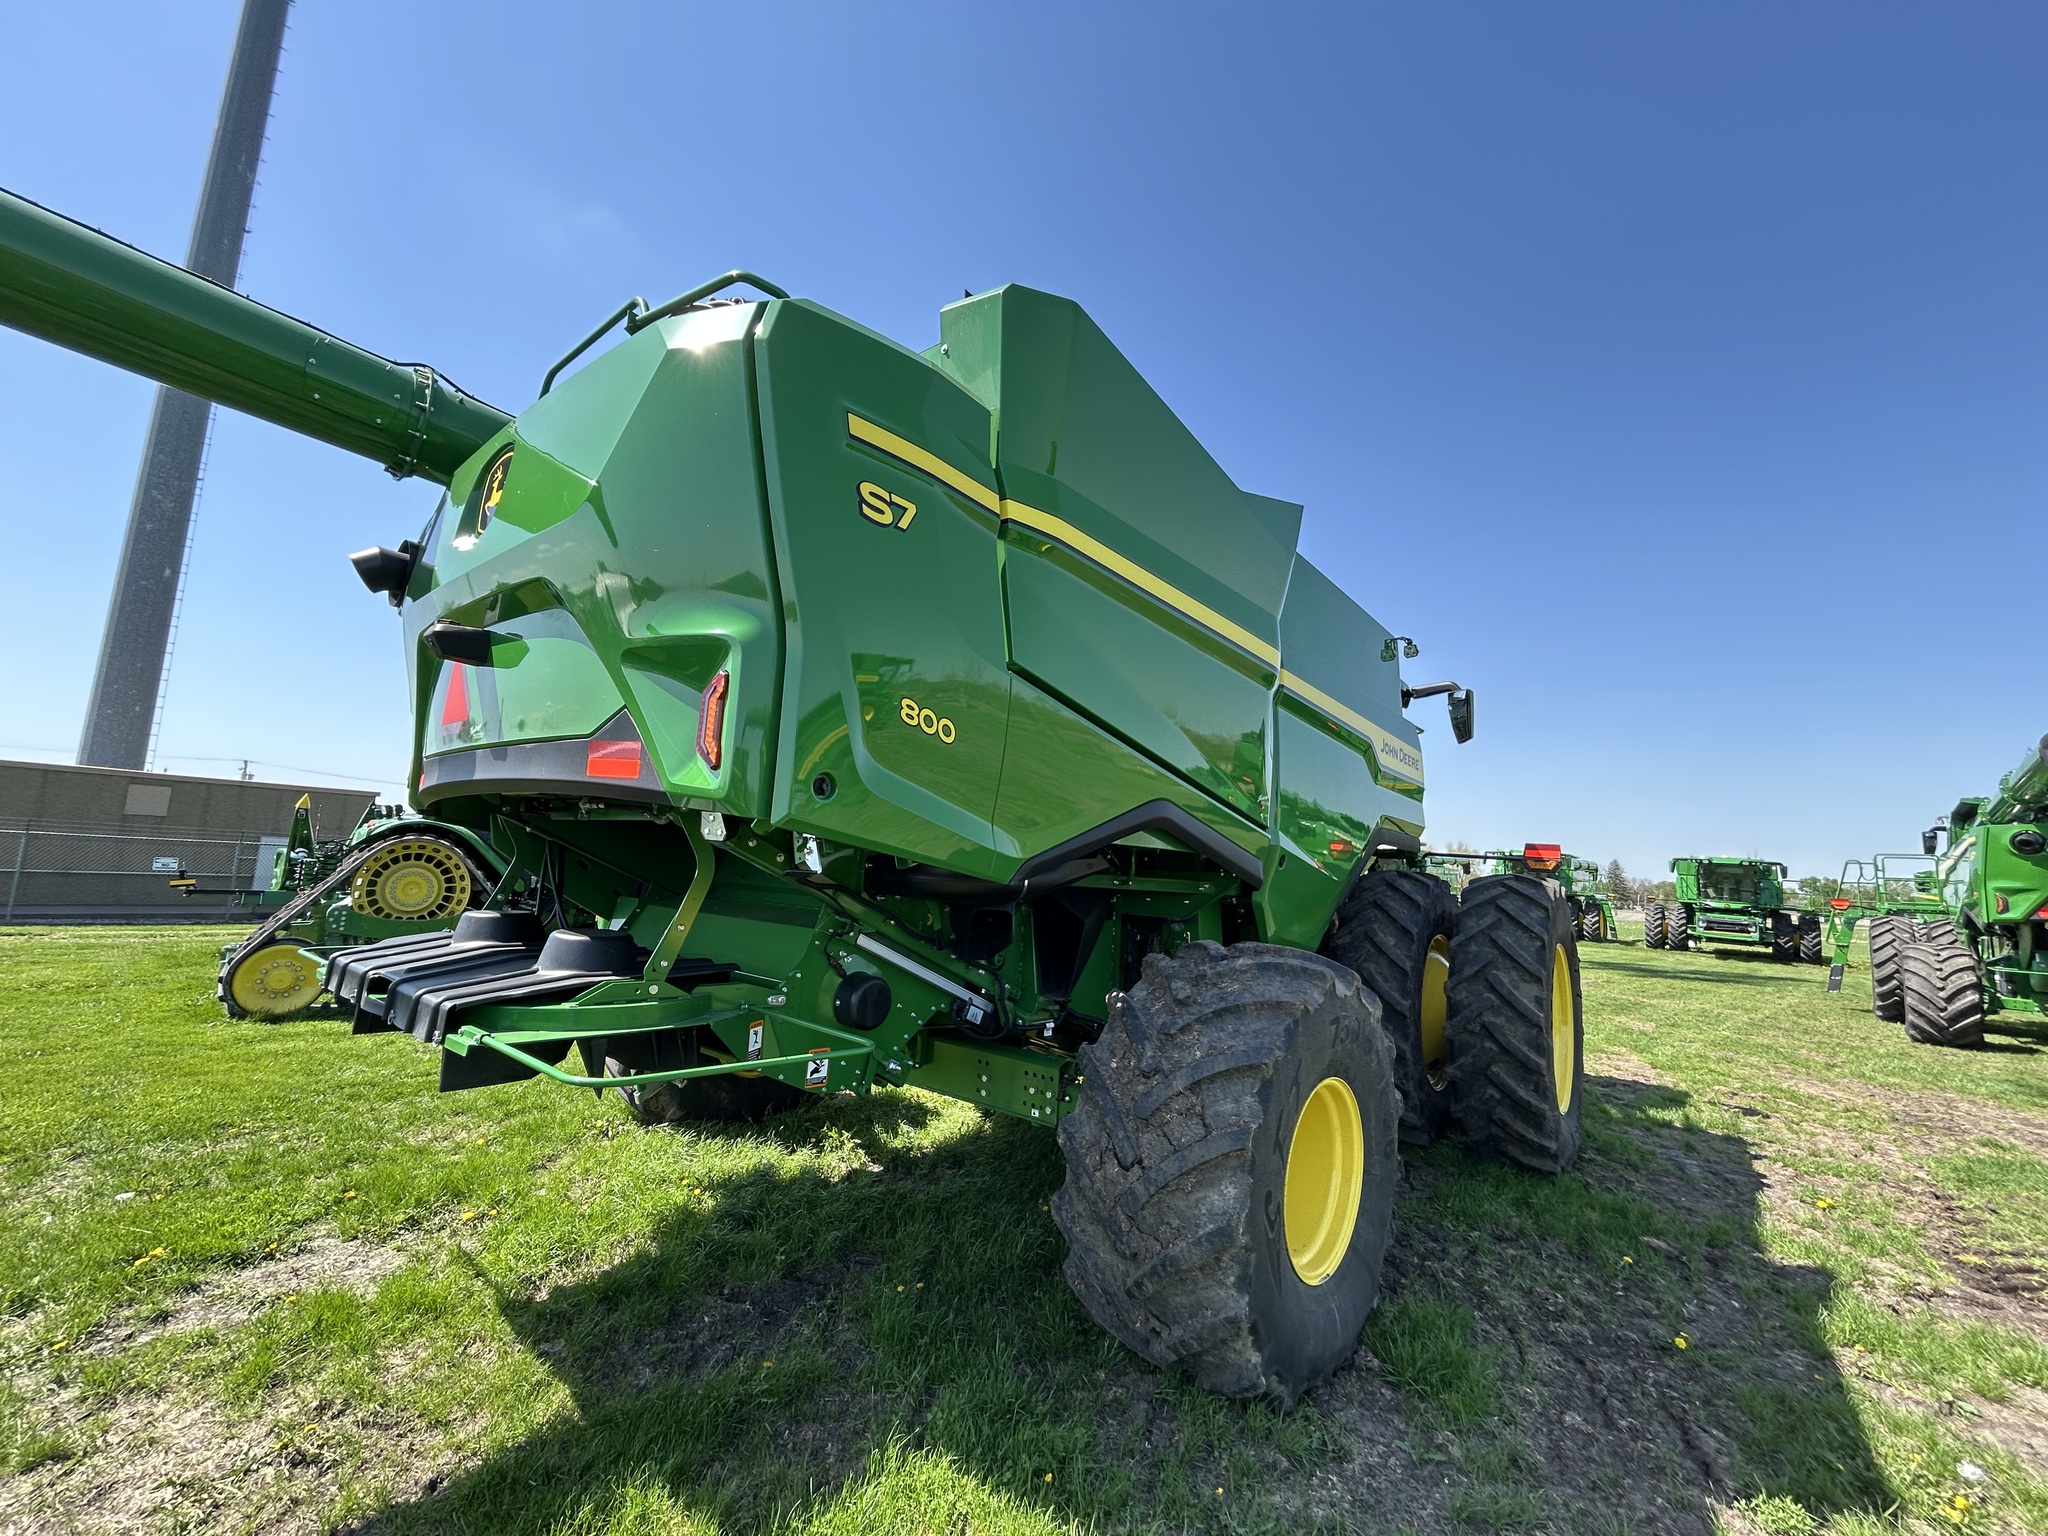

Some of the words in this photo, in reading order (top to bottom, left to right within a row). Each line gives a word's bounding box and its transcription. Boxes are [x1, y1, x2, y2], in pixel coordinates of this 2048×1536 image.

[858, 481, 917, 531] S7
[900, 697, 957, 745] 800
[1381, 738, 1399, 761] JOHN
[1399, 747, 1420, 771] DEERE
